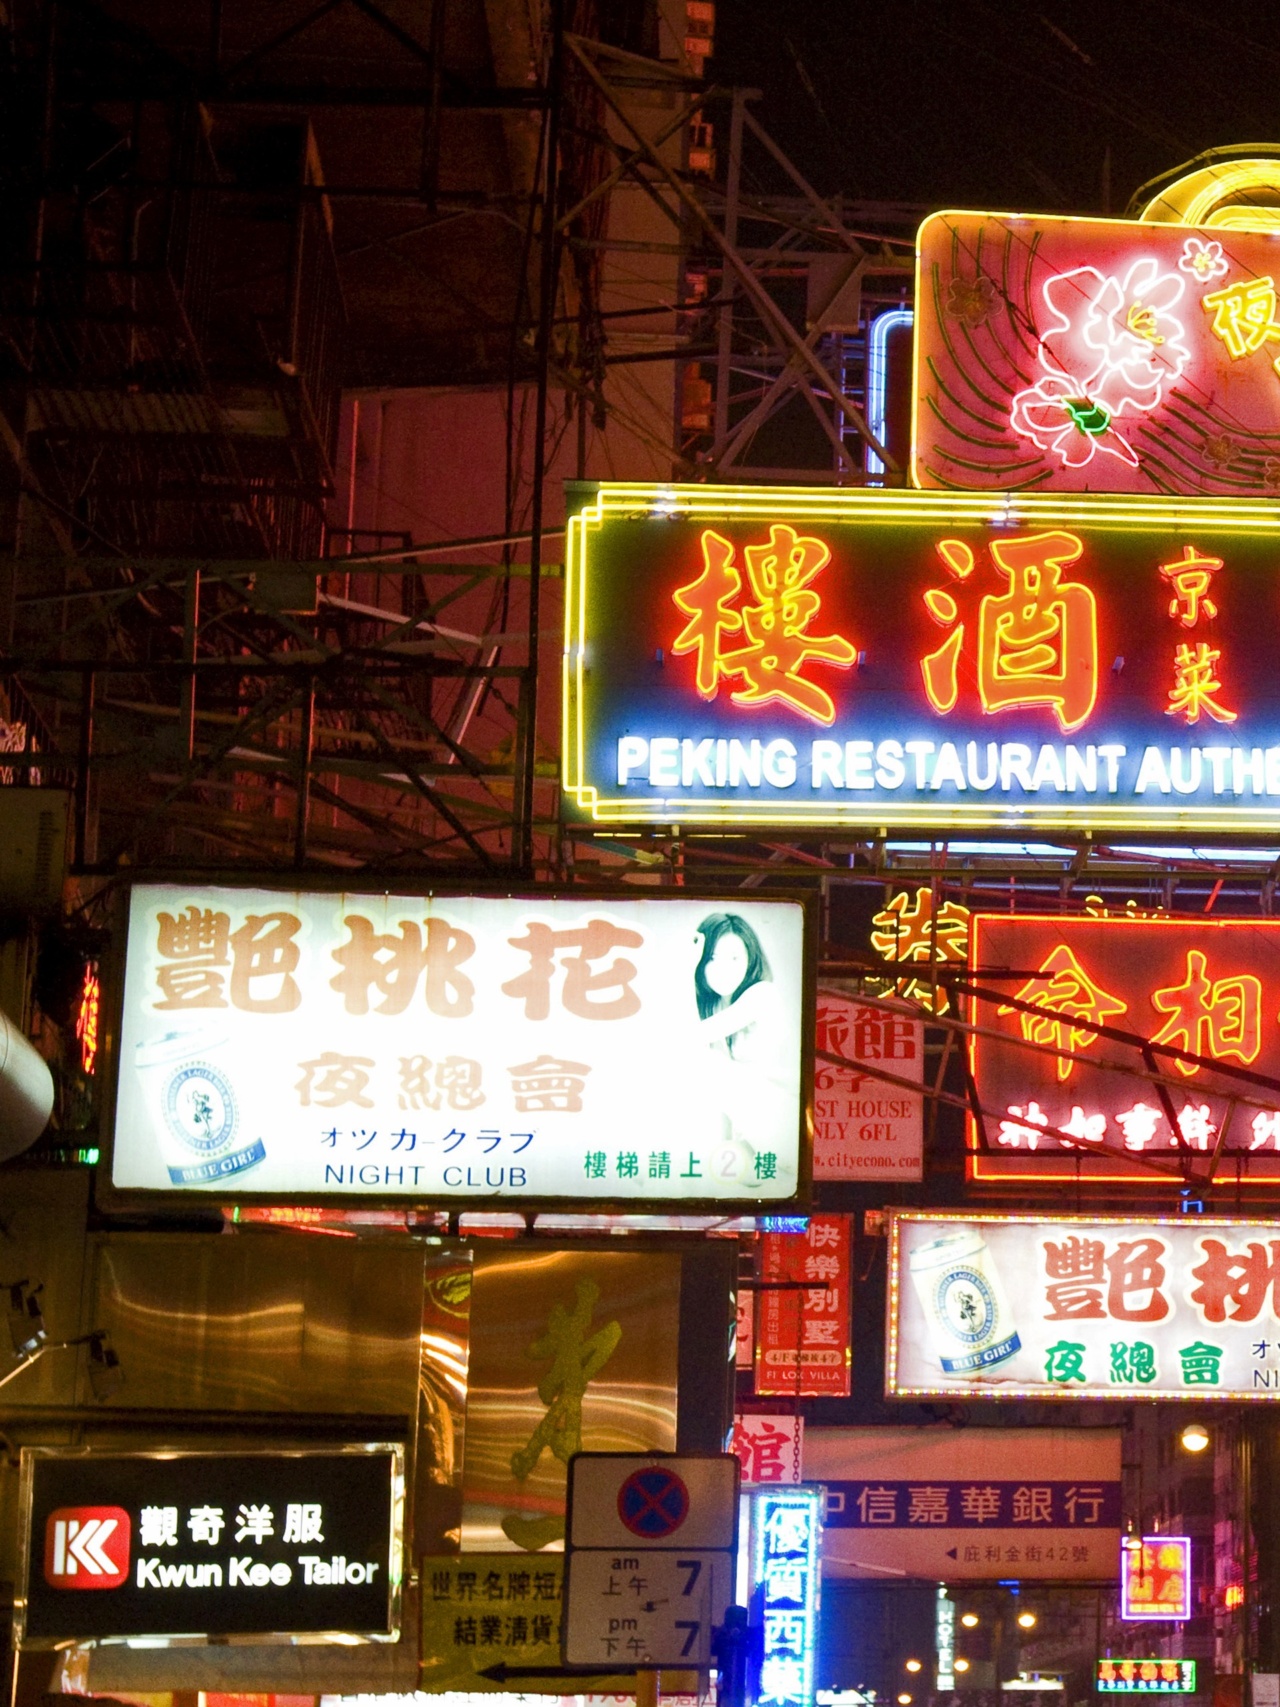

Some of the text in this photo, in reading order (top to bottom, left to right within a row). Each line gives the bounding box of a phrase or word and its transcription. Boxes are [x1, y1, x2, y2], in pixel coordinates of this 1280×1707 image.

[1160, 545, 1238, 723] 京菜
[617, 736, 799, 788] PEKING
[811, 740, 1126, 794] RESTAURANT
[294, 1050, 593, 1115] 夜總會
[848, 1100, 912, 1119] HOUSE
[814, 1122, 898, 1141] NLY 6FL
[182, 1147, 255, 1181] BLUE GIRL
[325, 1164, 527, 1187] NIGHT CLUB
[803, 1223, 842, 1345] 快樂別墅
[952, 1341, 1012, 1370] BLUE GIRL
[1043, 1340, 1227, 1385] 夜總會
[810, 1371, 840, 1380] VILLA
[823, 1486, 1104, 1523] 中信嘉華銀行
[140, 1504, 324, 1546] 觀奇洋服
[136, 1556, 379, 1588] Kwun Kee Tailor
[432, 1571, 564, 1600] 世界名牌短
[601, 1575, 649, 1596] 上午
[611, 1557, 702, 1596] am 7
[453, 1614, 562, 1647] 結業清貨
[601, 1637, 646, 1657] 下午
[609, 1617, 700, 1657] pm 7
